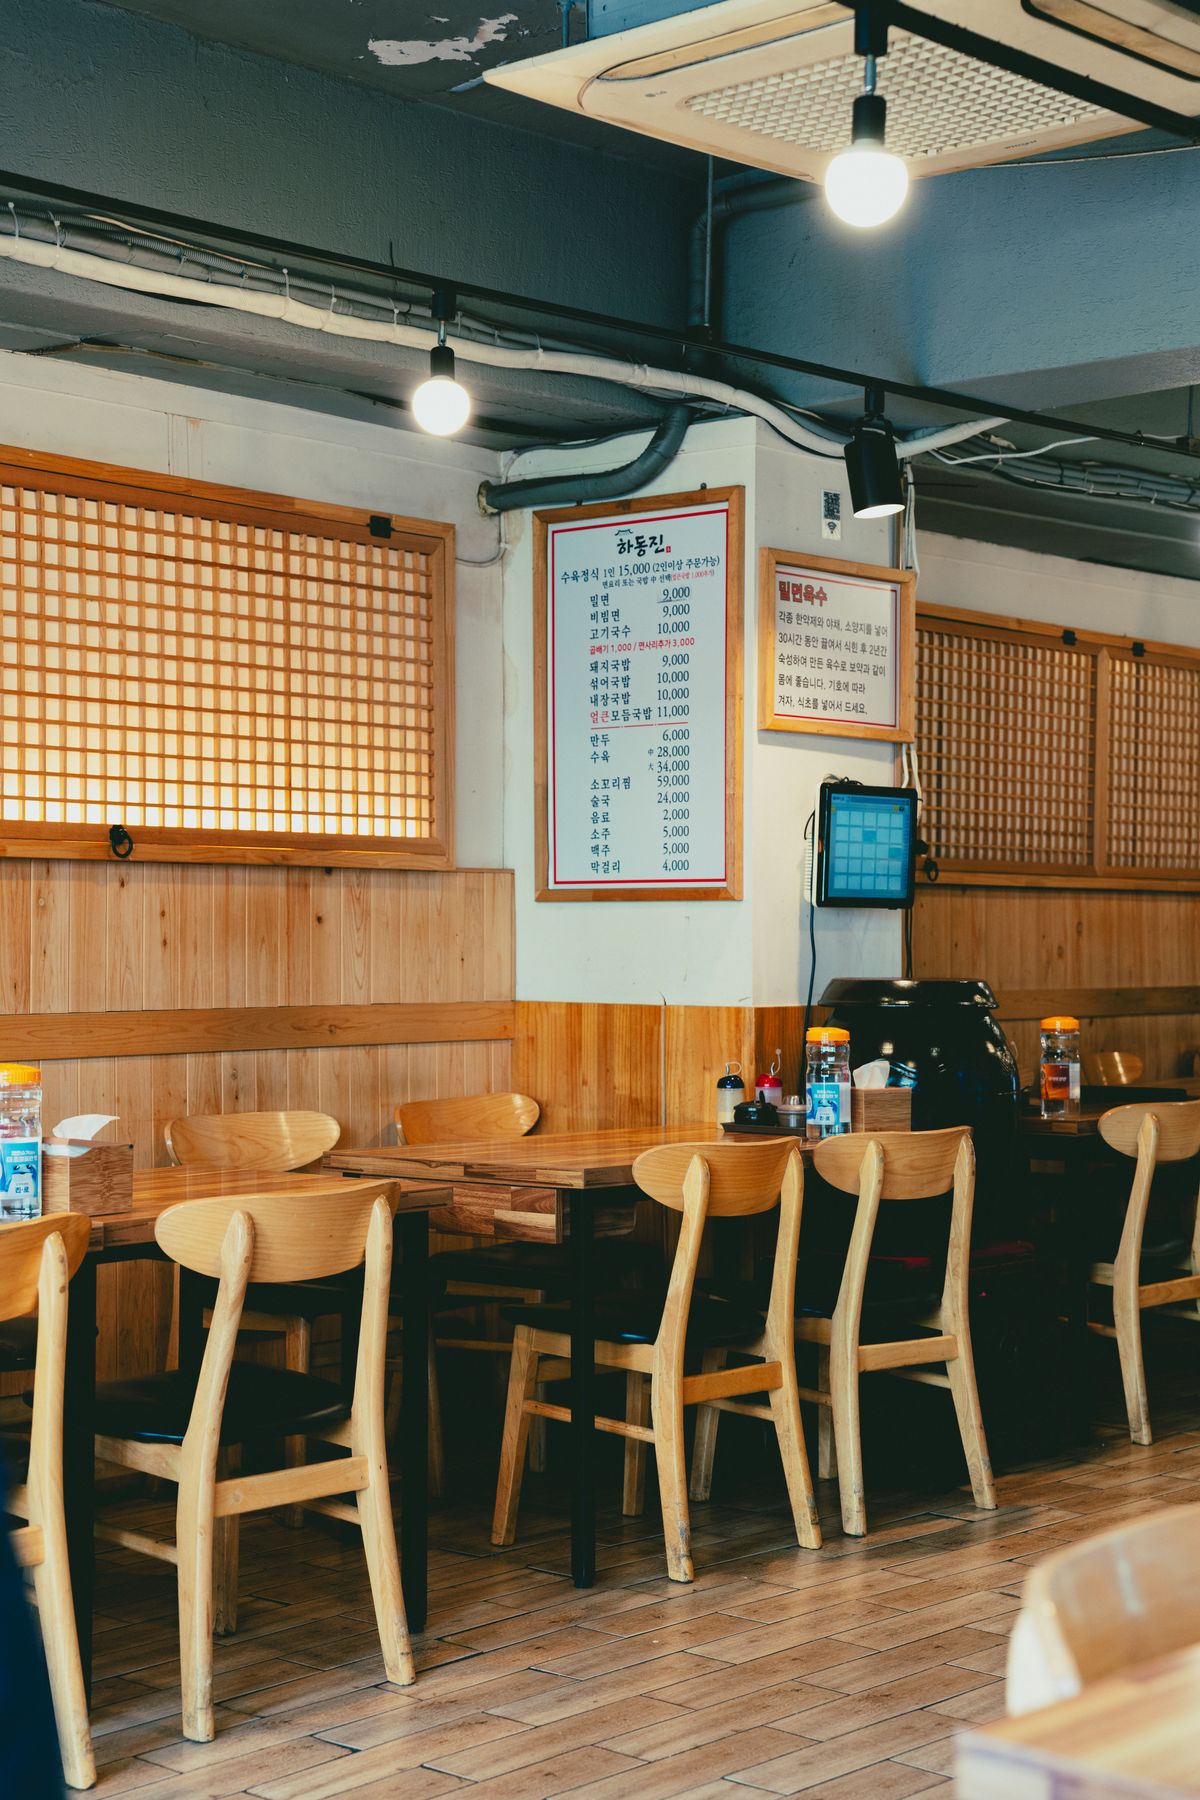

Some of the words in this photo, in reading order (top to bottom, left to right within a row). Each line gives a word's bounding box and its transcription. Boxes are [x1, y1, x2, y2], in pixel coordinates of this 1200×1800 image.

[617, 534, 664, 557] 하동진
[561, 568, 599, 584] 수육정식
[604, 567, 615, 578] 1인
[620, 562, 650, 576] 15,000
[653, 560, 683, 572] (2인이상
[686, 556, 720, 569] 주문가능)
[622, 578, 635, 587] 또는
[637, 577, 649, 585] 국밥
[590, 594, 609, 607] 밀면
[663, 587, 690, 600] 9,000
[779, 581, 828, 607] 밀면육수
[590, 609, 620, 624] 비빔면
[663, 604, 690, 618] 9,000
[779, 611, 793, 624] 각종
[845, 621, 872, 635] 소양지를
[590, 625, 631, 640] 고기국수
[658, 621, 690, 635] 10,000
[611, 644, 631, 654] 1,000
[638, 640, 671, 651] 면사리추가
[673, 638, 695, 648] 3,000
[779, 632, 802, 646] 30시간
[804, 635, 818, 648] 동안
[821, 638, 842, 651] 끓여서
[844, 641, 858, 654] 식힌
[860, 642, 867, 654] 후
[590, 658, 631, 673] 돼지국밥
[662, 654, 690, 667] 9,000
[779, 653, 807, 667] 숙성하여
[810, 657, 823, 670] 만든
[826, 659, 847, 672] 육수로
[849, 662, 870, 675] 보약과
[872, 664, 886, 677] 같이
[590, 675, 631, 691] 섞어국밥
[658, 670, 690, 684] 10,000
[779, 674, 792, 686] 몸에
[829, 680, 849, 692] 기호에
[852, 682, 866, 694] 따라
[590, 692, 631, 707] 내장국밥
[658, 688, 690, 701] 10,000
[798, 697, 818, 710] 식초를
[821, 699, 843, 712] 넣어서
[658, 705, 690, 718] 11,000
[590, 734, 610, 747] 만두
[663, 729, 690, 741] 6,000
[590, 751, 610, 764] 수육
[658, 745, 690, 758] 28,000
[657, 760, 690, 773] 34,000
[591, 776, 631, 790] 소꼬리찜
[657, 775, 690, 788] 59,000
[591, 795, 610, 808] 술국
[658, 792, 690, 804] 24,000
[591, 812, 610, 824] 음료
[663, 808, 690, 821] 2,000
[591, 828, 610, 840] 소주
[663, 826, 690, 838] 5,000
[591, 844, 610, 857] 맥주
[663, 842, 690, 855] 5,000
[591, 860, 621, 874] 막걸리
[662, 859, 690, 872] 4,000
